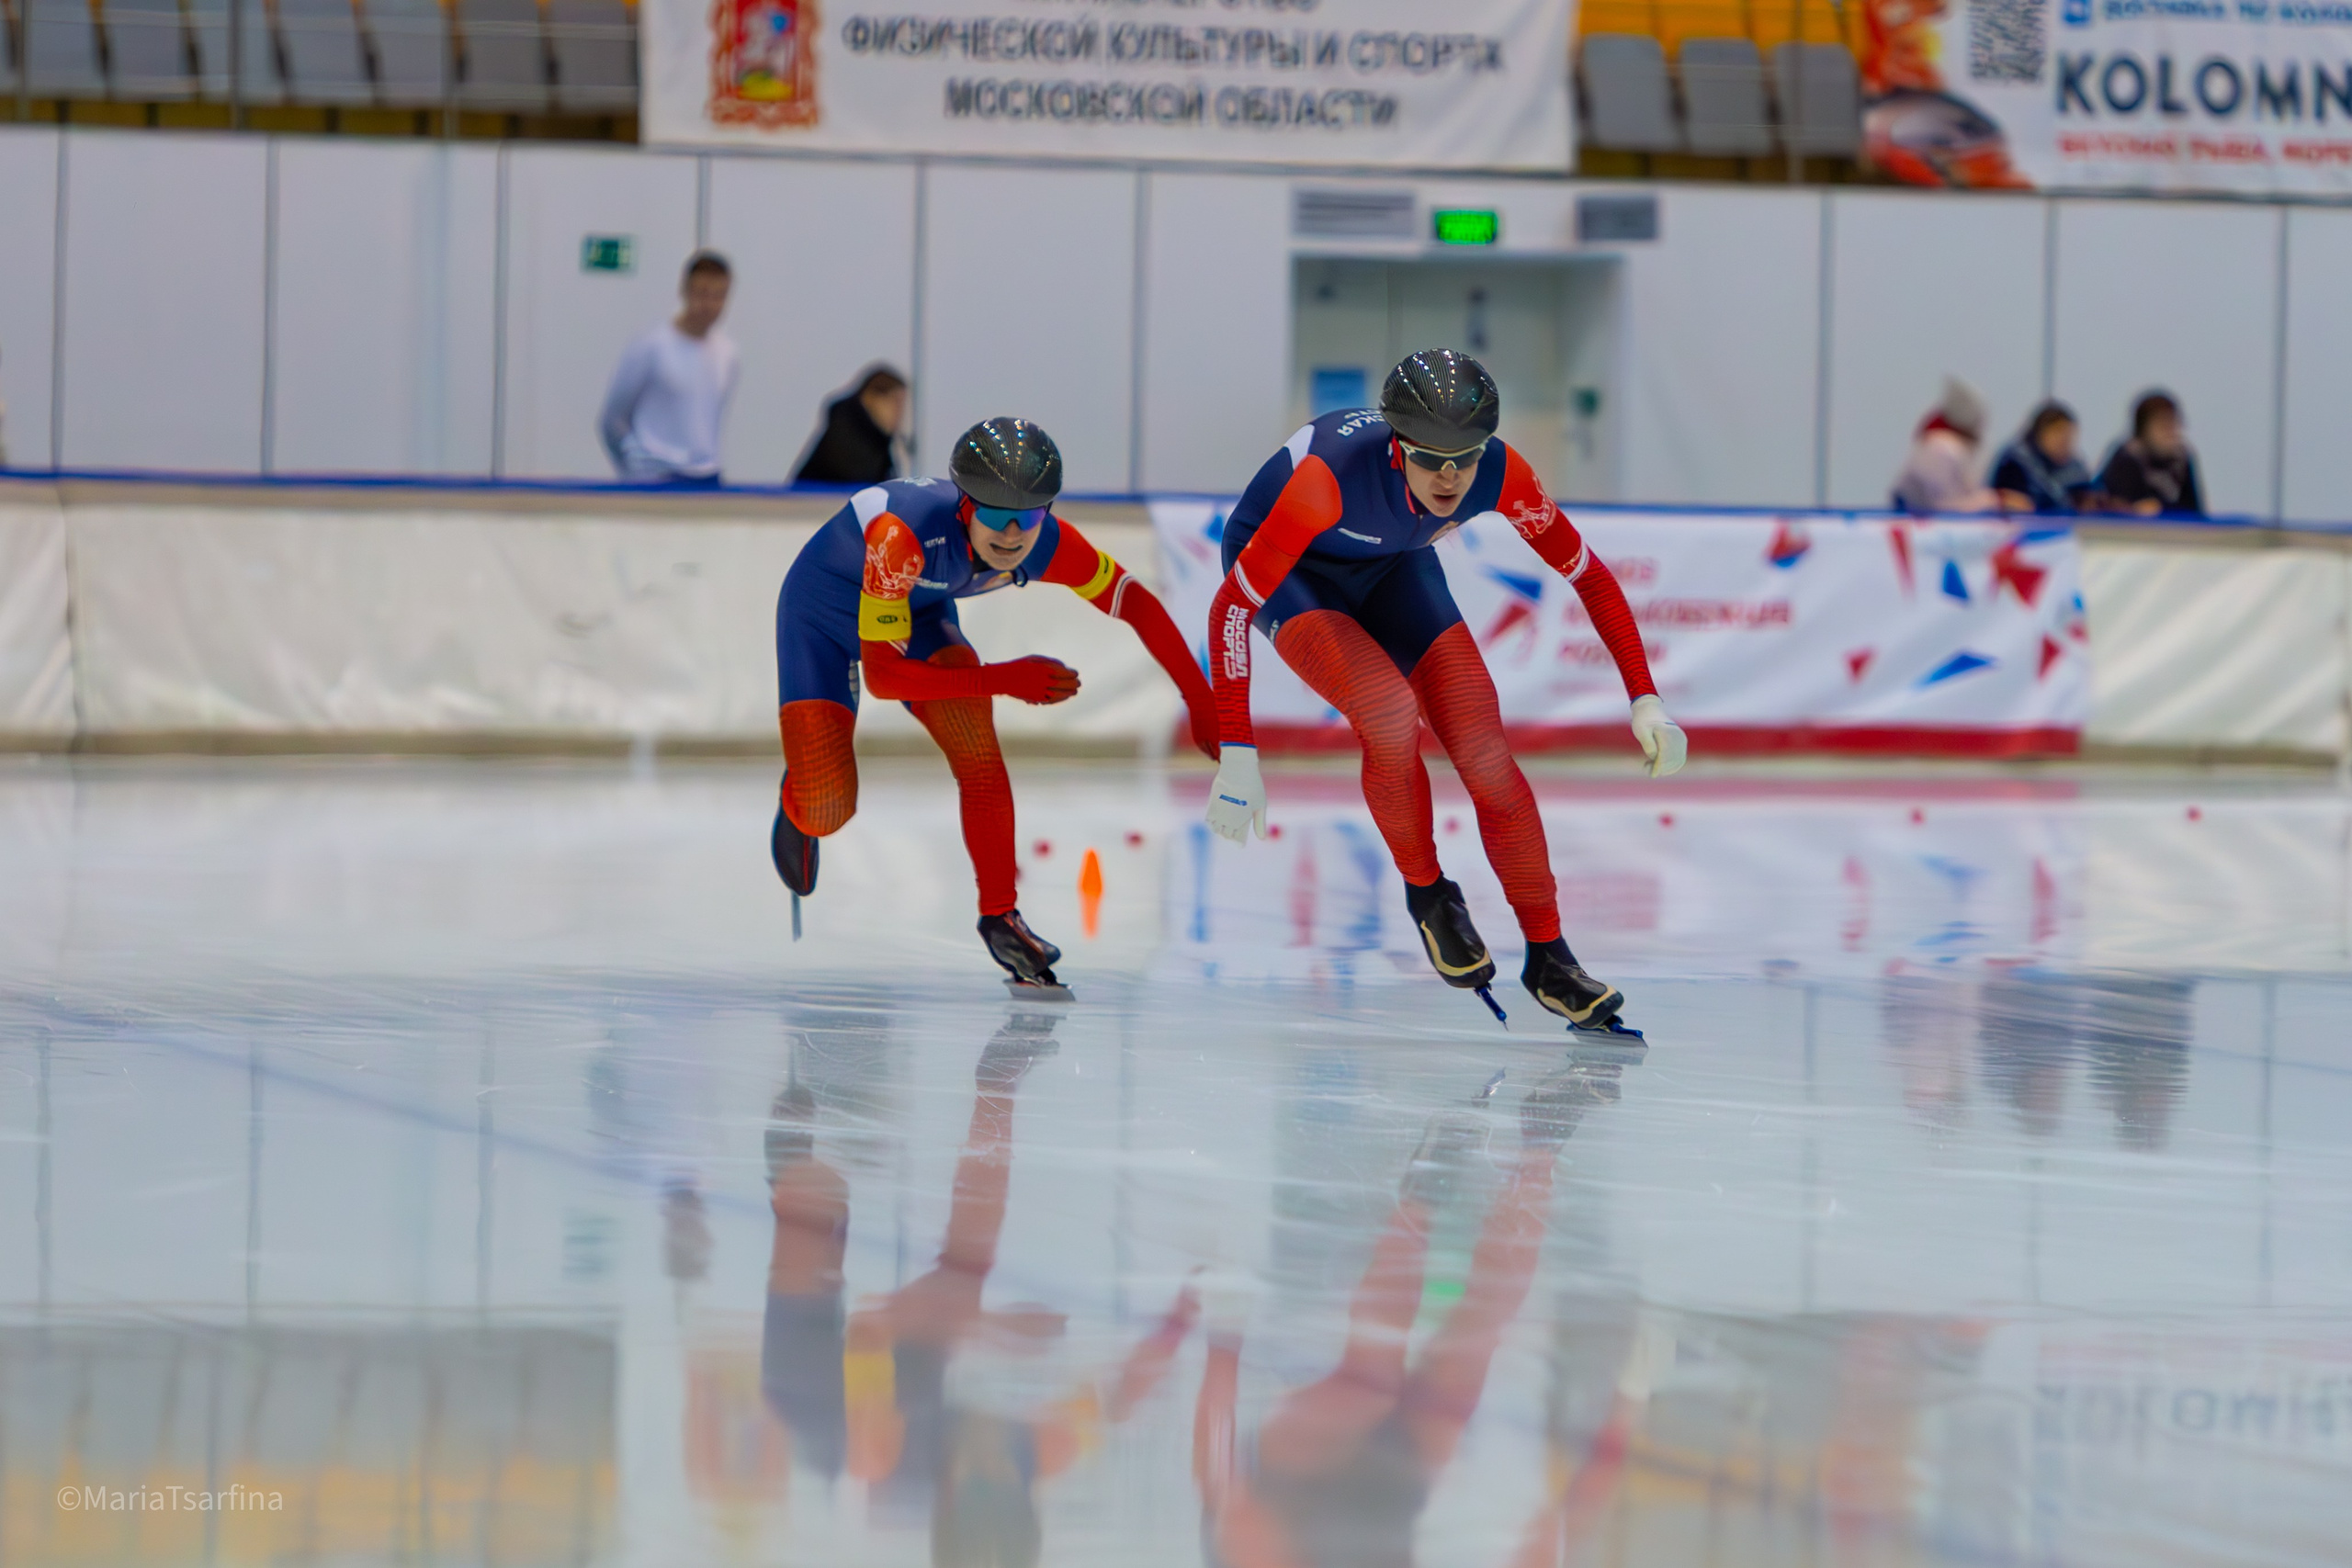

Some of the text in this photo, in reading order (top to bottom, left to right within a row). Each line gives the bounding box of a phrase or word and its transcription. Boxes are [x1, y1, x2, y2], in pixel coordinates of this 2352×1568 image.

[842, 13, 1504, 73] ФИЗИЧЕСКОЙ КУЛЬТУРЫ И СПОРТА
[944, 76, 1398, 129] МОСКОВСКОЙ ОБЛАСТИ
[2057, 51, 2352, 122] KOLOMN
